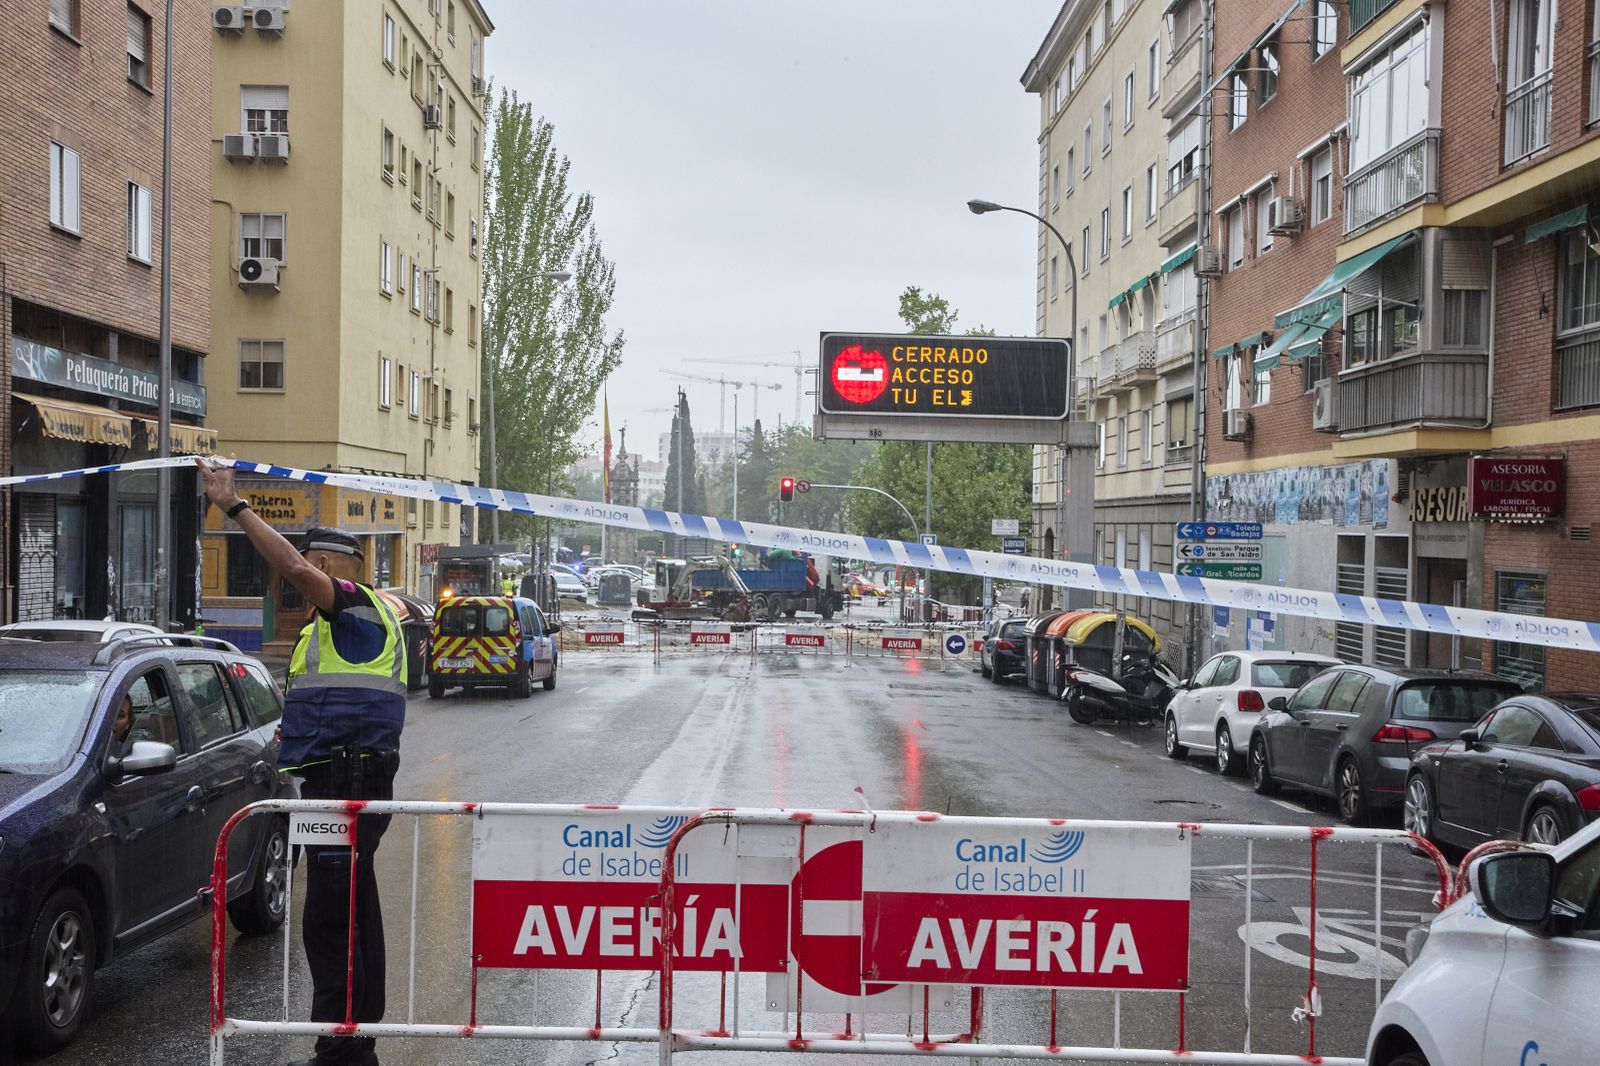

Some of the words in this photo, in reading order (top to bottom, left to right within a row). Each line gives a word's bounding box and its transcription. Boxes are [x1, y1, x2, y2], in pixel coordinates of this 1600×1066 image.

[892, 346, 988, 364] CERRADO
[66, 358, 129, 392] Peluquería
[132, 375, 175, 403] Princa
[892, 368, 973, 385] ACCESO
[891, 388, 917, 405] TU
[1491, 465, 1546, 475] ASESORIA
[1480, 480, 1557, 493] VELASCO
[250, 494, 294, 507] Taberna
[1408, 487, 1477, 523] ASESOR
[251, 507, 296, 519] rtesana
[1234, 545, 1260, 553] Parque
[589, 633, 619, 643] AVERÍA
[695, 633, 725, 643] AVERÍA
[790, 636, 819, 645] AVERÍA
[887, 639, 917, 649] AVERÍA
[296, 823, 348, 834] INESCO
[562, 823, 632, 848] Canal
[955, 838, 1026, 863] Canal
[562, 851, 591, 877] de
[599, 852, 661, 878] Isabe
[955, 865, 985, 891] de
[994, 866, 1063, 892] Isabel
[512, 894, 744, 959] AVERÍA
[906, 909, 1144, 975] AVERÍA
